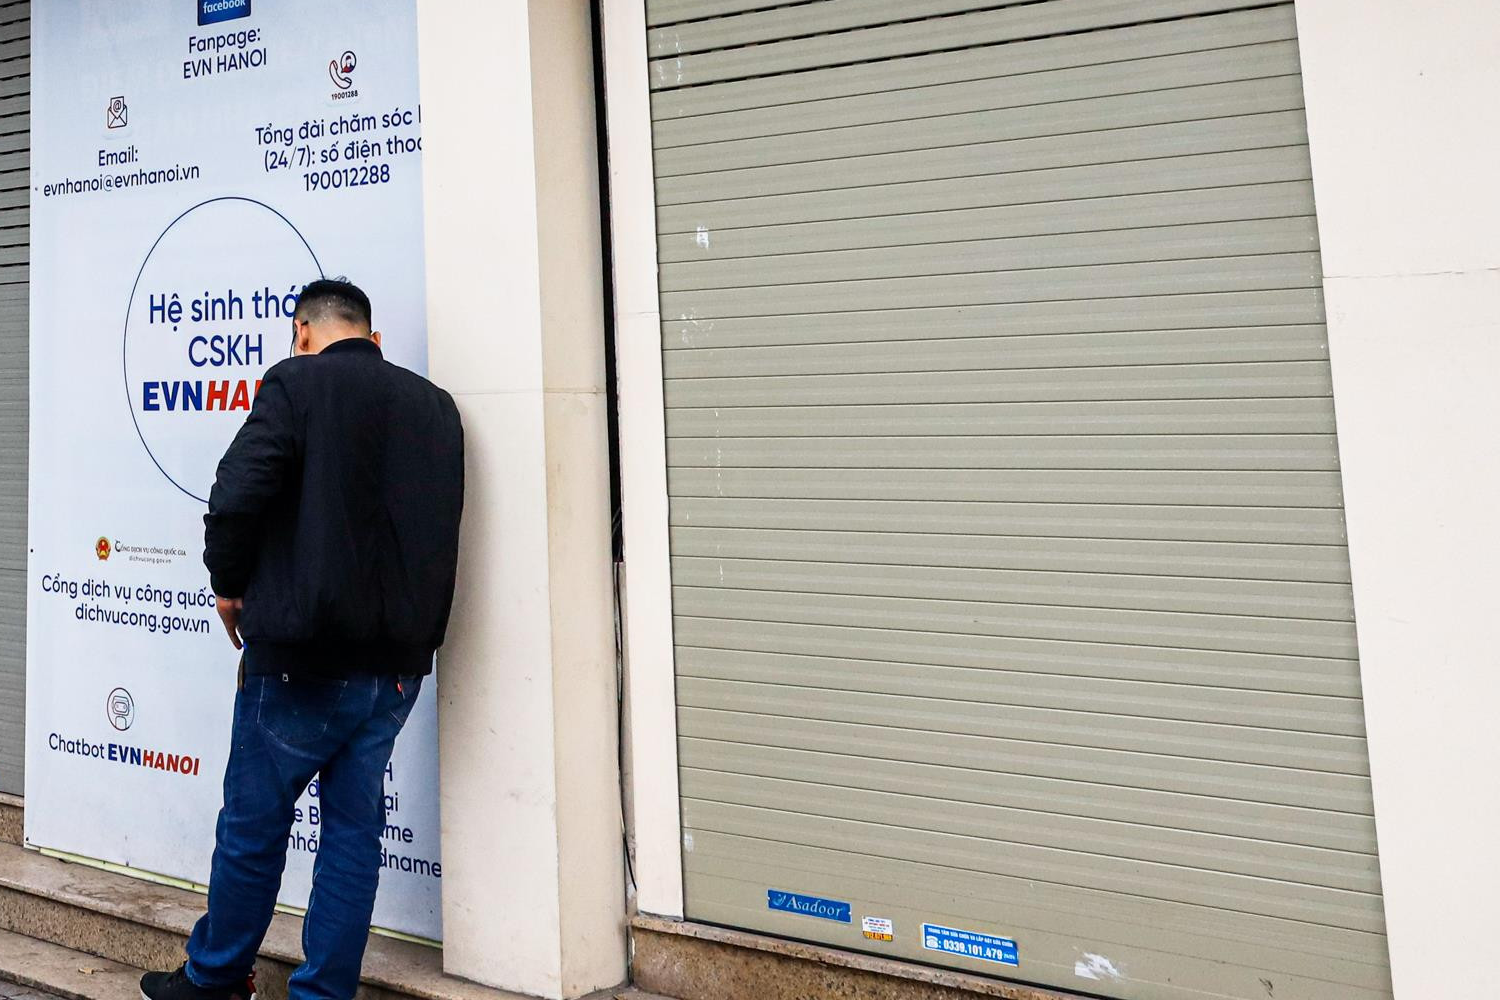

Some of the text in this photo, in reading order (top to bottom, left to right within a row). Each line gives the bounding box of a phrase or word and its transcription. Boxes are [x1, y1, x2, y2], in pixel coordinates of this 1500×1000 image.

[188, 27, 261, 54] Fanpage:
[182, 47, 267, 80] EVN HANOI
[331, 90, 359, 101] 19001288
[255, 123, 294, 147] Tổng
[298, 119, 325, 141] đài
[329, 113, 377, 136] chăm
[382, 107, 413, 129] sóc
[98, 147, 139, 168] Email:
[264, 144, 316, 173] (24/7):
[320, 141, 339, 164] số
[344, 139, 382, 164] điện
[43, 165, 200, 198] evnhanoi@evnhanoi.vn
[303, 163, 391, 192] 190012288
[149, 285, 308, 332] Hệ sinh thá
[188, 333, 263, 368] CSKH
[142, 379, 264, 412] EVNHA
[42, 573, 216, 610] Cổng dịch vụ công quốc
[75, 603, 210, 634] dichvucong.gov.vn
[49, 732, 200, 776] Chatbot EVNHANOI
[786, 895, 844, 918] Asadoor
[943, 939, 1003, 960] 0339.101.479
